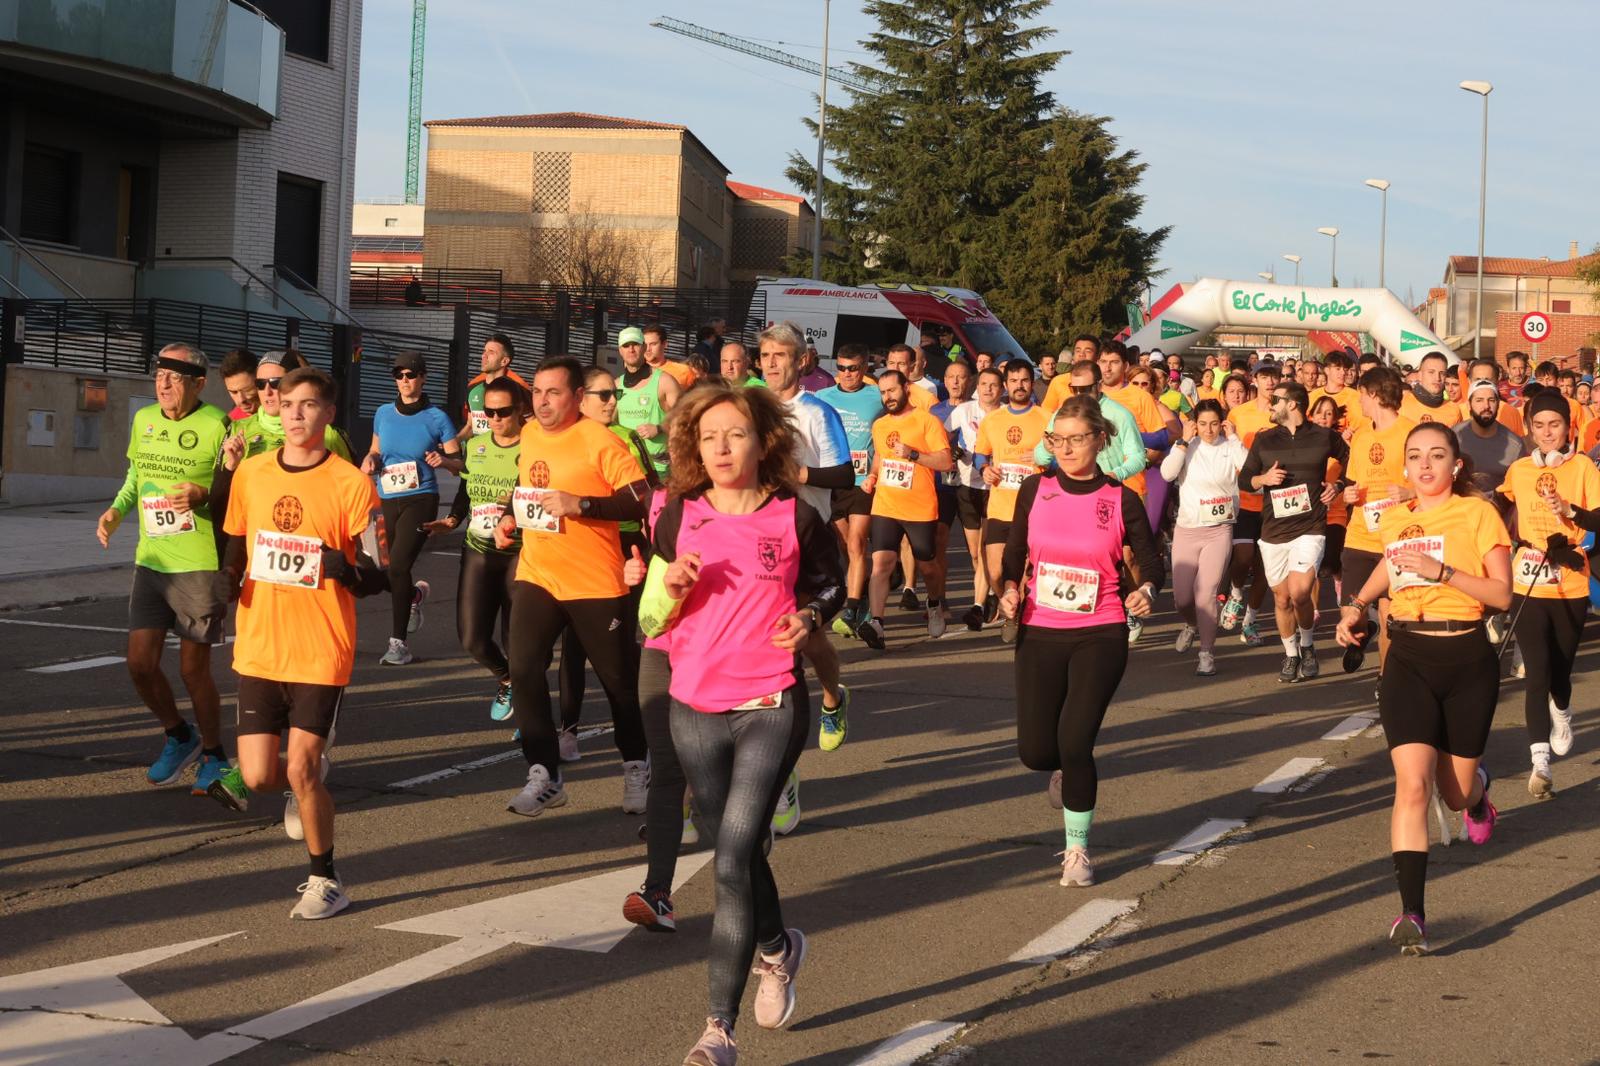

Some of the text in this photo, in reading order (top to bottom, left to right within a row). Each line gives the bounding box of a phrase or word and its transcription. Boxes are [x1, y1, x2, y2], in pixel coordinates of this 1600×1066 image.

[821, 289, 878, 300] AMBULANCIA
[1232, 290, 1361, 322] El Corte Inglés
[805, 327, 828, 338] Roja
[1528, 322, 1544, 332] 30
[137, 462, 186, 475] CARBAJOSA
[391, 474, 406, 486] 93
[887, 469, 905, 481] 178
[1284, 497, 1299, 509] 64
[1530, 501, 1550, 512] UPS
[527, 504, 544, 520] 87
[1212, 505, 1225, 516] 68
[155, 510, 175, 526] 50
[257, 534, 320, 554] bedunia
[267, 551, 305, 573] 109
[1522, 562, 1549, 578] 341
[1053, 583, 1077, 601] 46
